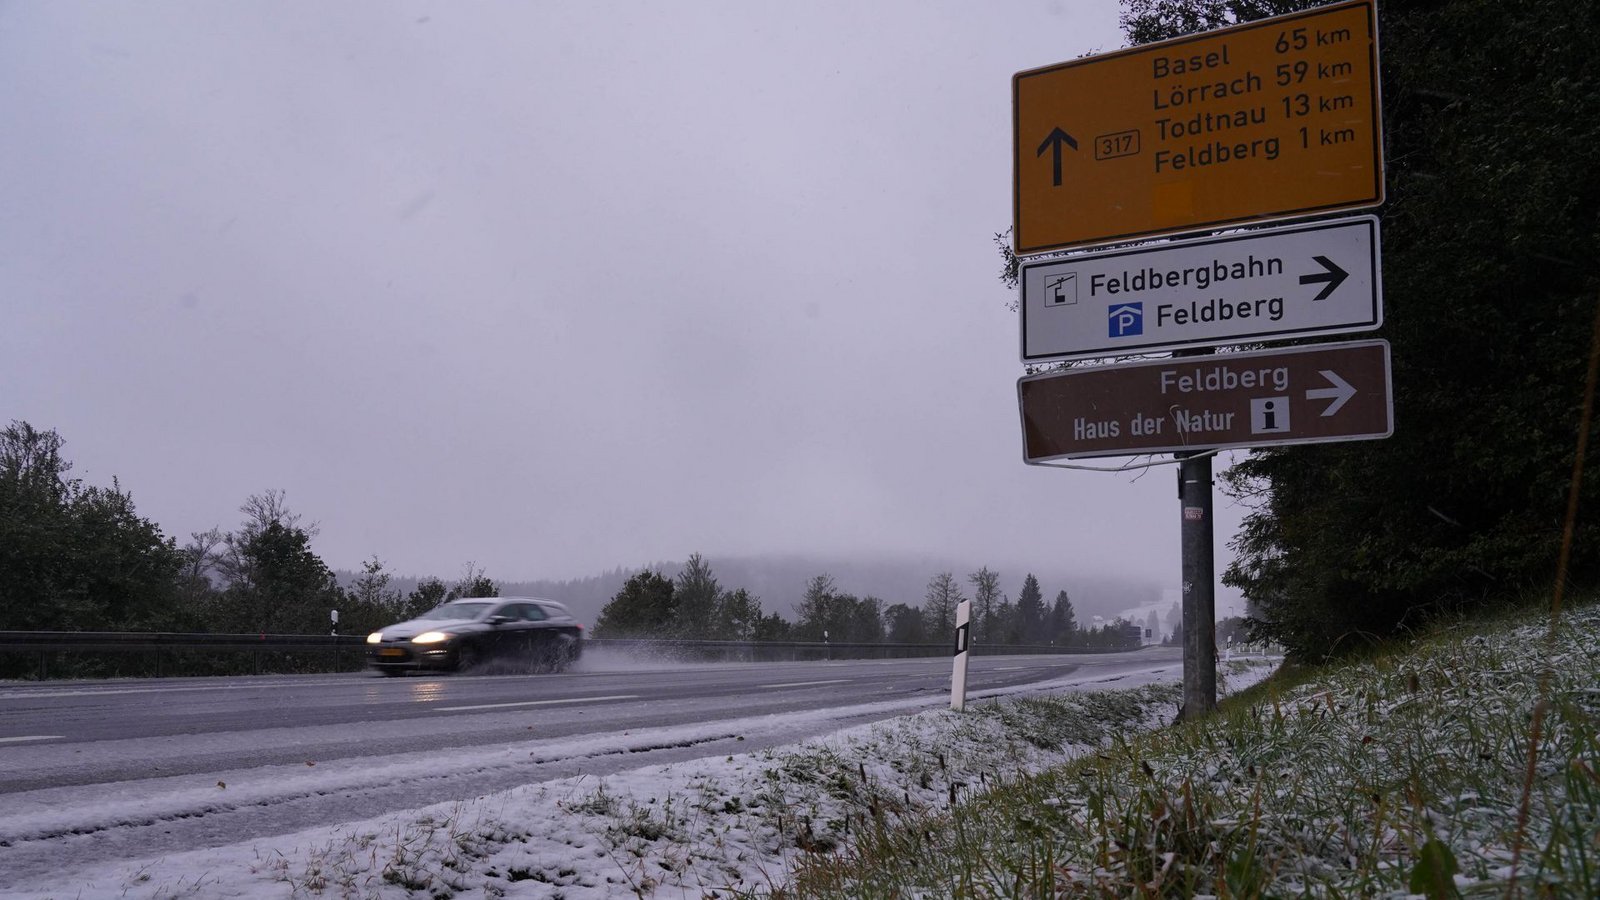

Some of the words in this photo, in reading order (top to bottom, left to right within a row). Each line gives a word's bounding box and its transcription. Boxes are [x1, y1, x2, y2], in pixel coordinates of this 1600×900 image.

[1153, 44, 1230, 79] Basel
[1275, 28, 1308, 54] 65
[1316, 26, 1350, 46] km
[1154, 72, 1261, 110] Lörrach
[1276, 61, 1309, 86] 59
[1317, 60, 1352, 79] km
[1155, 105, 1266, 140] Todtnau
[1282, 94, 1310, 118] 13
[1319, 93, 1354, 112] km
[1102, 135, 1133, 155] 317
[1155, 136, 1280, 173] Feldberg
[1299, 127, 1309, 148] 1
[1320, 126, 1355, 146] km
[1090, 256, 1283, 296] Feldbergbahn
[1157, 297, 1284, 327] Feldberg
[1160, 367, 1289, 394] Feldberg
[1074, 418, 1120, 440] Haus
[1131, 413, 1165, 436] der
[1176, 410, 1235, 434] Natur
